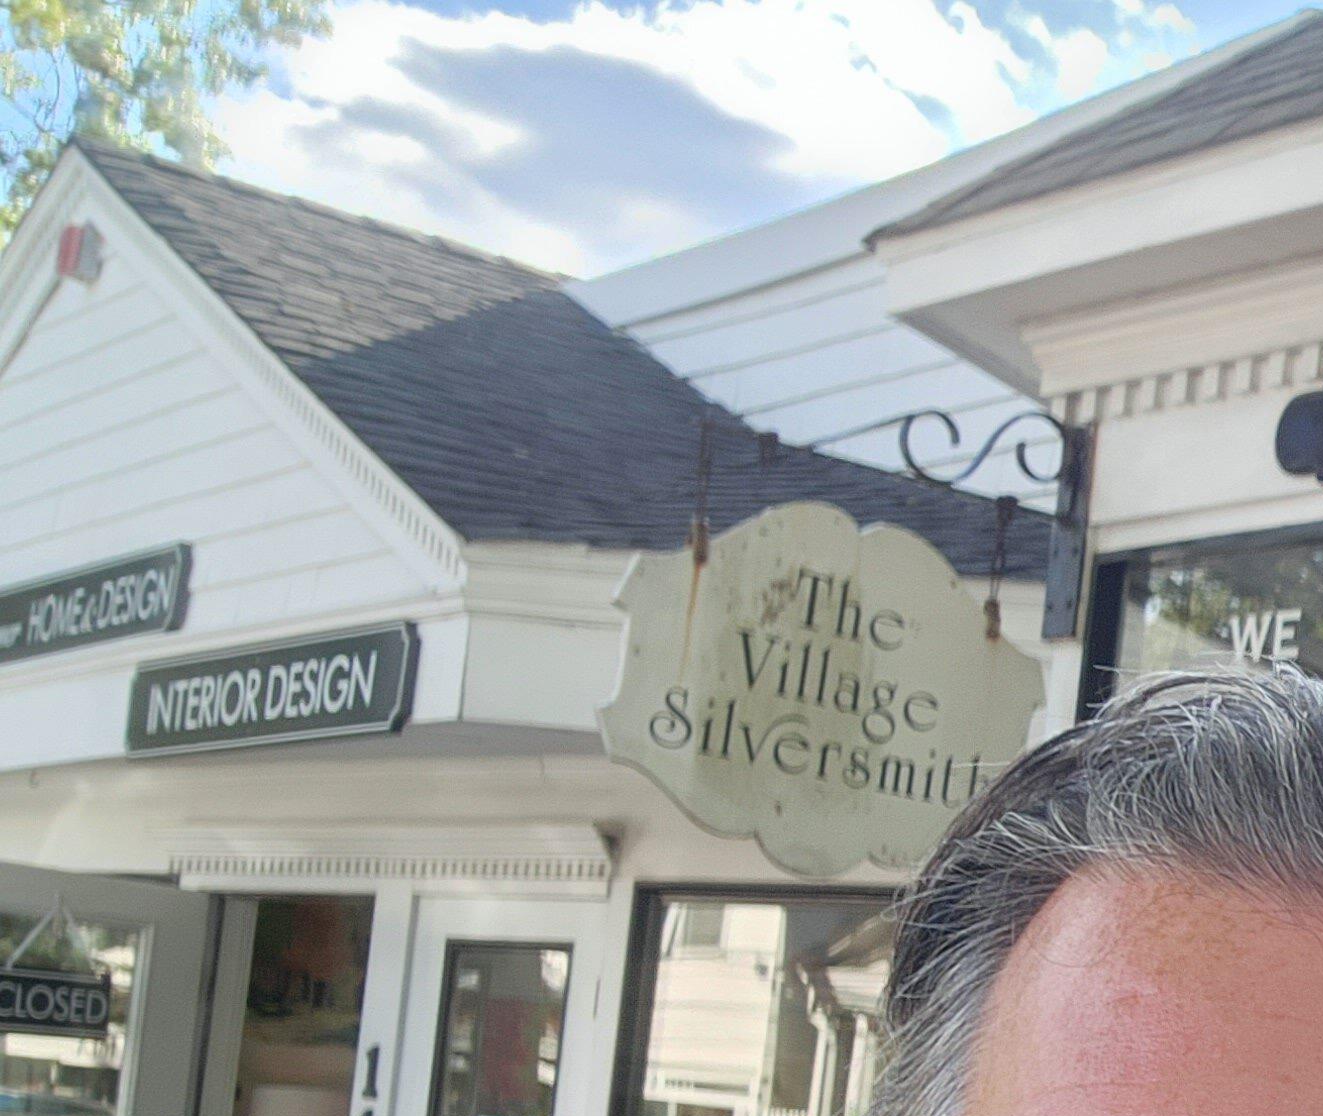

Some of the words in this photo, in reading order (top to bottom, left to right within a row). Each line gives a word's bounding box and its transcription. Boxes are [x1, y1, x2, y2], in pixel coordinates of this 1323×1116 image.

[27, 587, 85, 646] HOME
[97, 564, 177, 630] DESIGN
[796, 568, 907, 651] The
[1229, 607, 1302, 664] WE
[146, 667, 262, 736] INTERIOR
[263, 649, 378, 720] DESIGN
[737, 627, 939, 745] Village
[0, 980, 108, 1025] CLOSED
